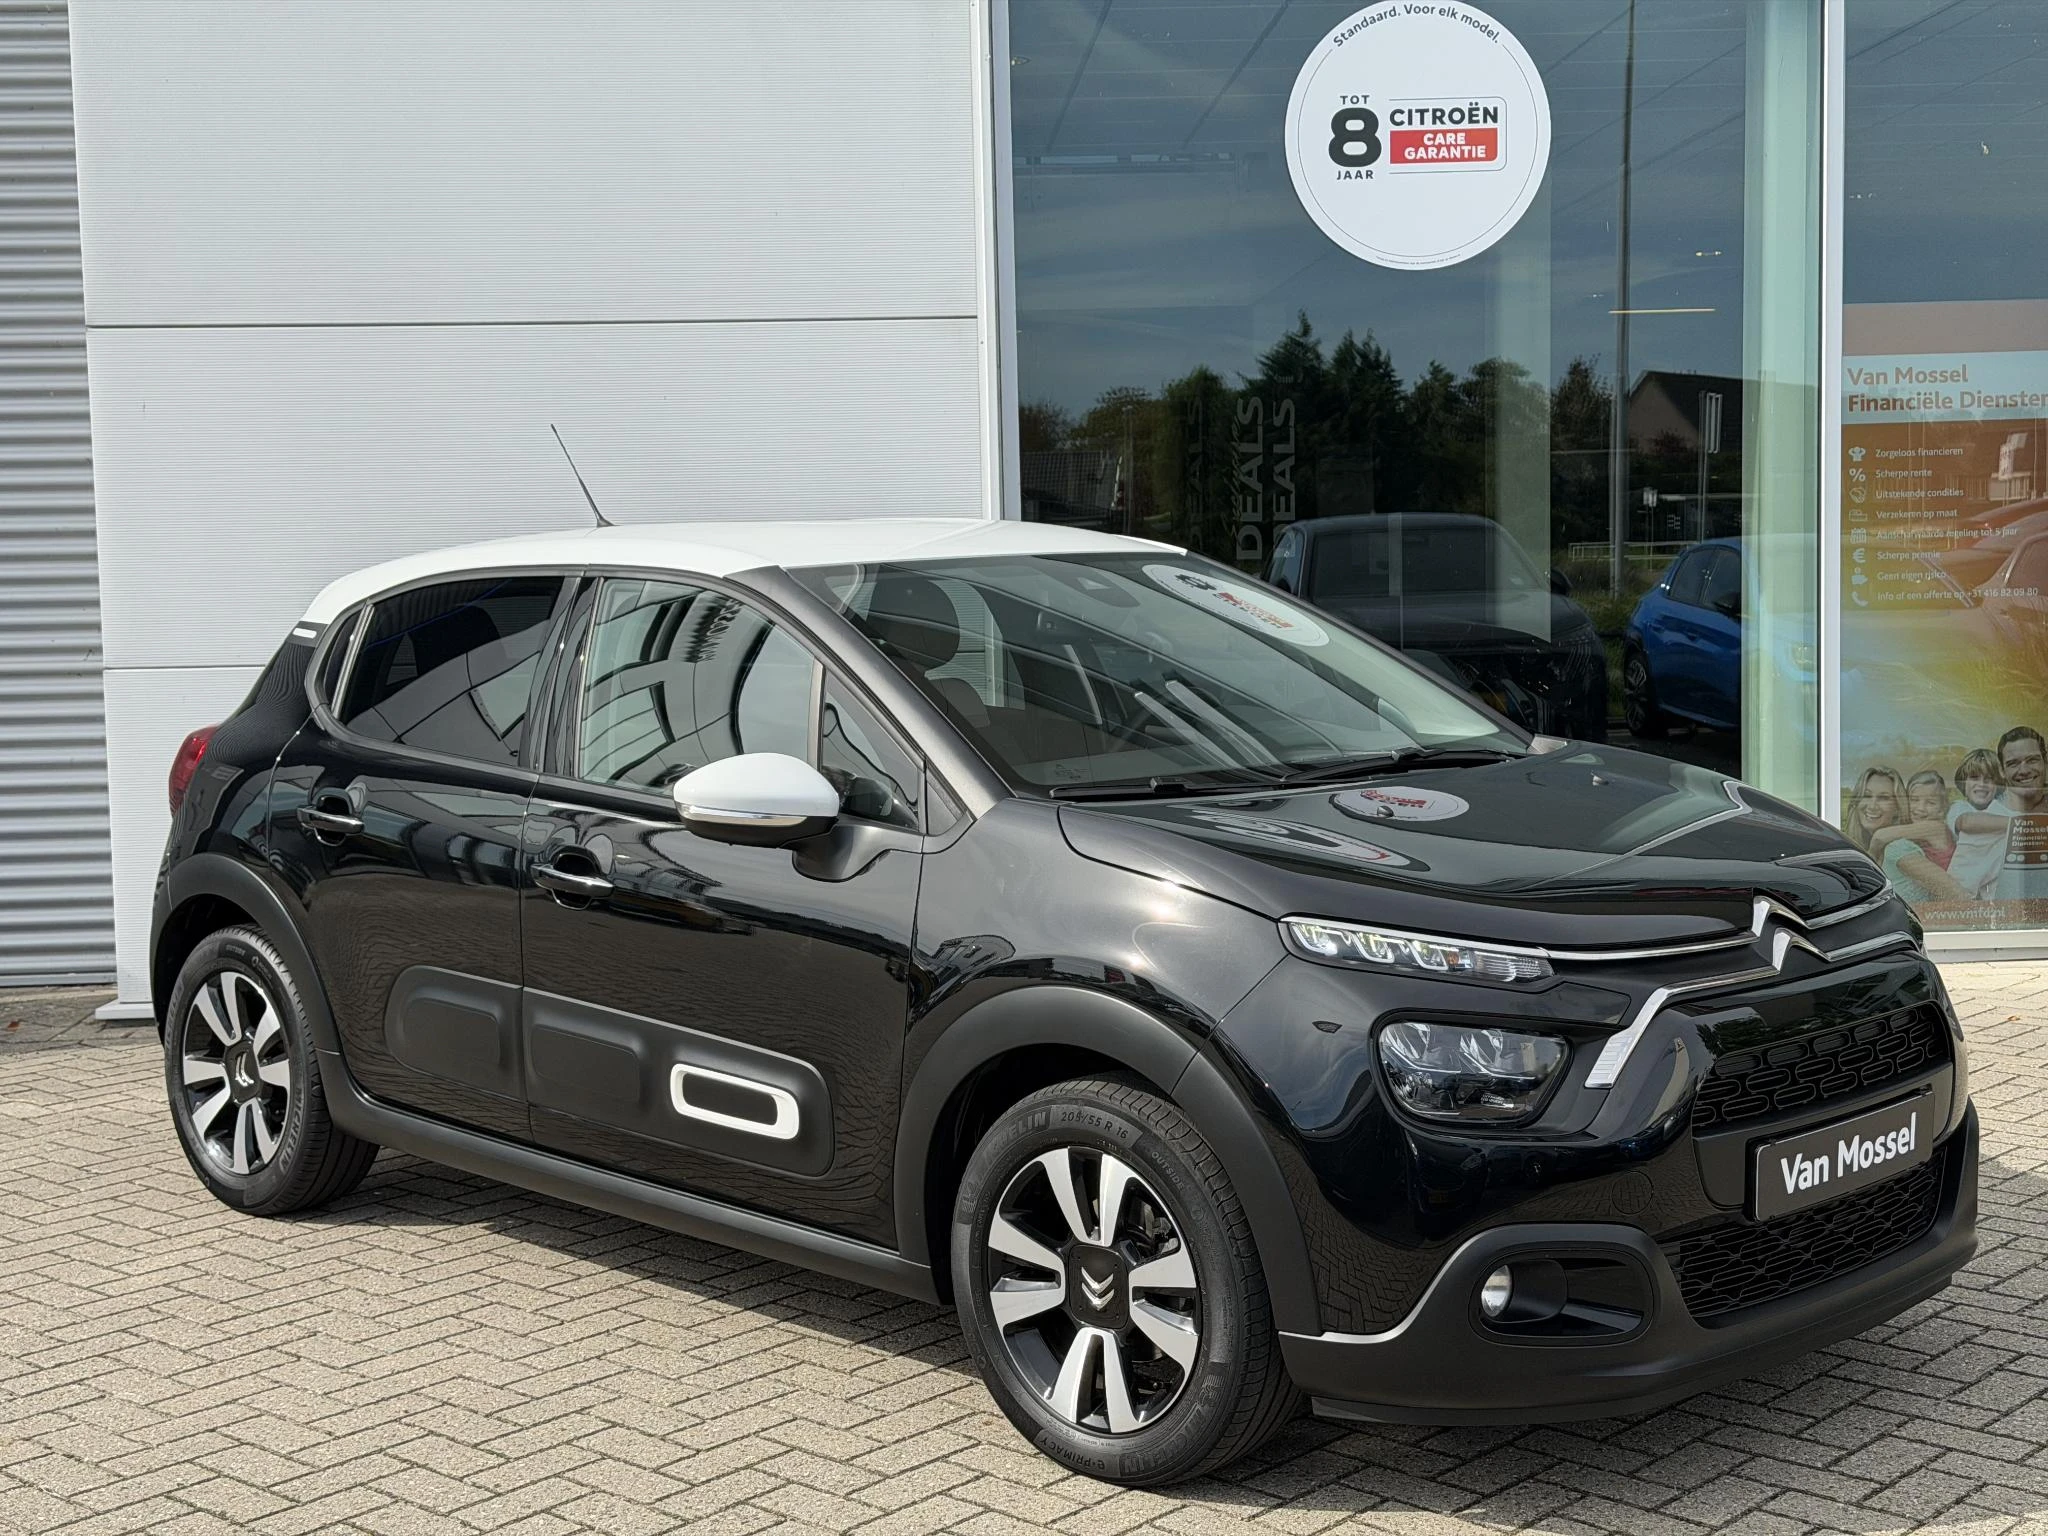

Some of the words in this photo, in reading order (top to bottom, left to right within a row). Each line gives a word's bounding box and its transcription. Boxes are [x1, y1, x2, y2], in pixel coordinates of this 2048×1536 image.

[1333, 5, 1401, 47] Standaard.
[1404, 3, 1436, 15] Voor
[1438, 6, 1459, 20] elk
[1460, 13, 1500, 44] model.
[1340, 95, 1370, 105] TOT
[1389, 102, 1499, 126] CITROËN
[1328, 107, 1382, 167] 8
[1423, 132, 1466, 145] CARE
[1404, 145, 1486, 160] GARANTIE
[1336, 170, 1374, 180] JAAR
[1847, 367, 1888, 385] Van
[1895, 364, 1969, 384] Mossel
[1848, 391, 1953, 412] Financiële
[1875, 449, 1916, 460] Zorgeloos
[1918, 447, 1964, 457] financieren
[1236, 396, 1264, 560] DEALS
[1875, 470, 1909, 480] Scherpe
[1910, 469, 1933, 477] rente
[1876, 490, 1925, 499] Uitstekende
[1927, 489, 1964, 498] condities
[1877, 510, 1922, 519] Verzekeren
[1924, 511, 1935, 520] op
[1936, 509, 1958, 518] maat
[1877, 551, 1910, 561] Scherpe
[1104, 1120, 1113, 1132] R
[1117, 1127, 1129, 1139] 16
[1780, 1153, 1830, 1194] Van
[1837, 1112, 1917, 1178] Mossel
[1151, 1151, 1185, 1191] OUTSIDE
